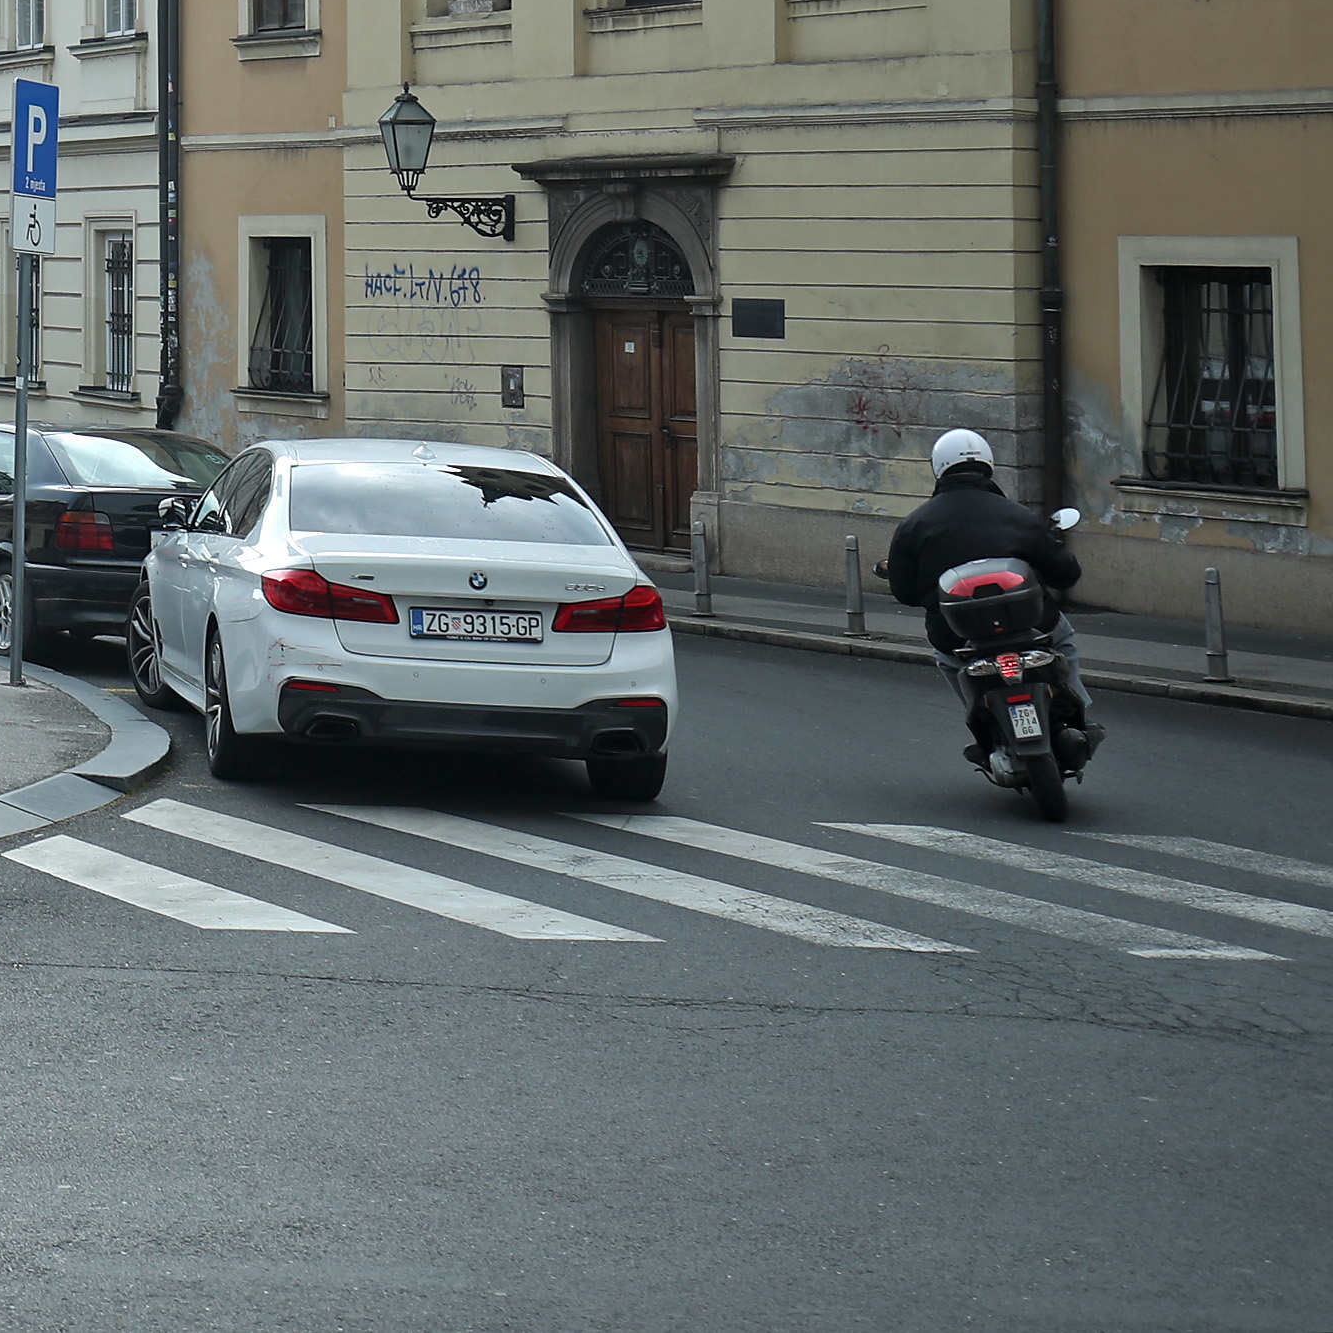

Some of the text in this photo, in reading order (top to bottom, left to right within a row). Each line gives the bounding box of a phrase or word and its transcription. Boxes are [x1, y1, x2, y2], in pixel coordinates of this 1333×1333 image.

[26, 104, 48, 173] P
[25, 177, 29, 188] 2
[425, 612, 449, 633] ZG
[1018, 709, 1030, 717] ZG
[1014, 717, 1037, 727] 7714
